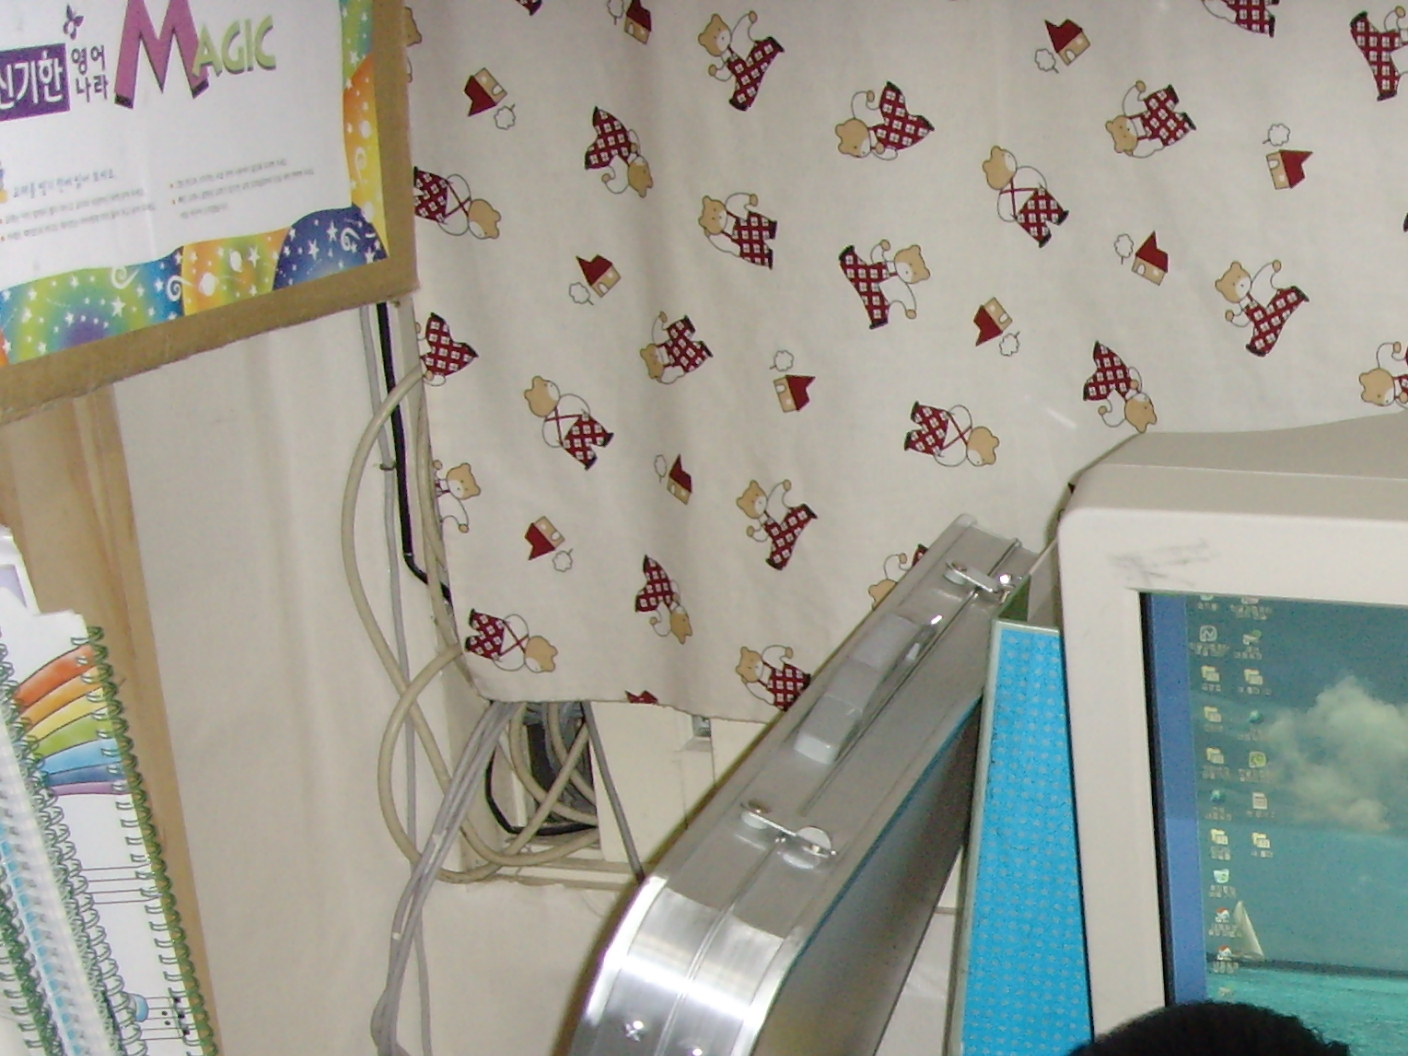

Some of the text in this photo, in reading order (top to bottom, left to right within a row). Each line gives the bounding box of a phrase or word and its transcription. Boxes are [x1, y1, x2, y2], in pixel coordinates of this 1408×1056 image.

[71, 45, 106, 76] 영어
[114, 0, 277, 109] MAGIC
[75, 74, 110, 103] 나라
